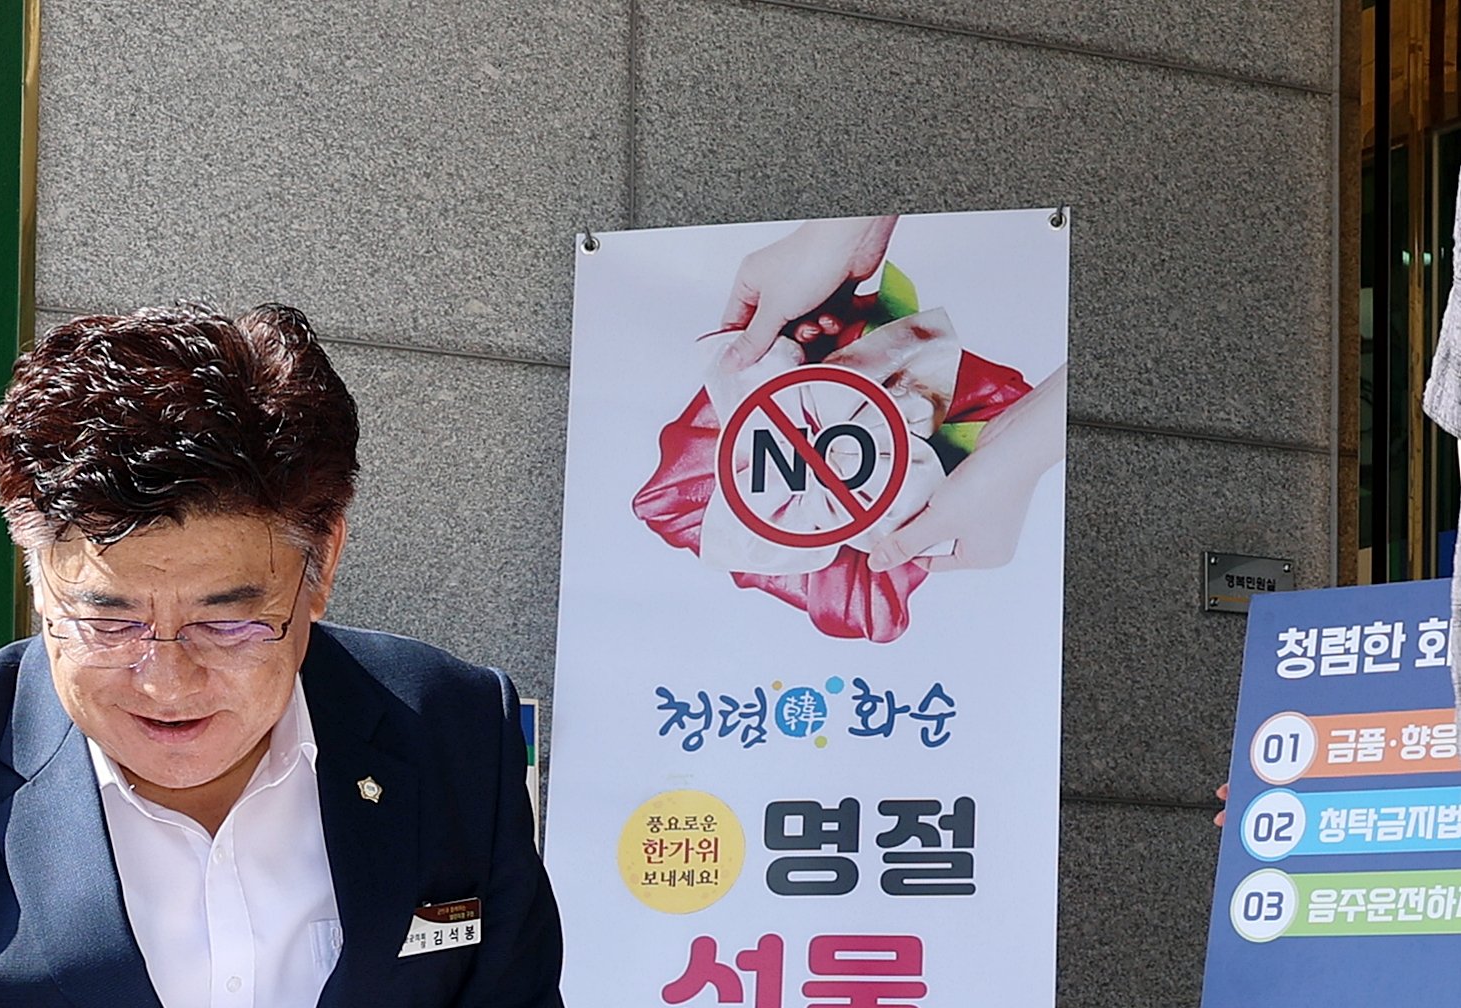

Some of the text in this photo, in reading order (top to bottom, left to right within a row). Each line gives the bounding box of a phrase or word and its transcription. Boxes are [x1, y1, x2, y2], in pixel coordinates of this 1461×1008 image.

[751, 424, 876, 493] NO
[1225, 574, 1276, 592] 행복민원실
[1276, 621, 1406, 679] 청렴한
[655, 686, 768, 752] 청렴
[848, 677, 957, 748] 화순
[1263, 733, 1300, 764] 01
[646, 814, 717, 833] 풍요로운
[1253, 805, 1461, 843] 02 청탁금지법
[642, 837, 720, 864] 한가위
[763, 796, 976, 896] 명절
[641, 869, 719, 887] 보내세요!
[1243, 891, 1284, 921] 03
